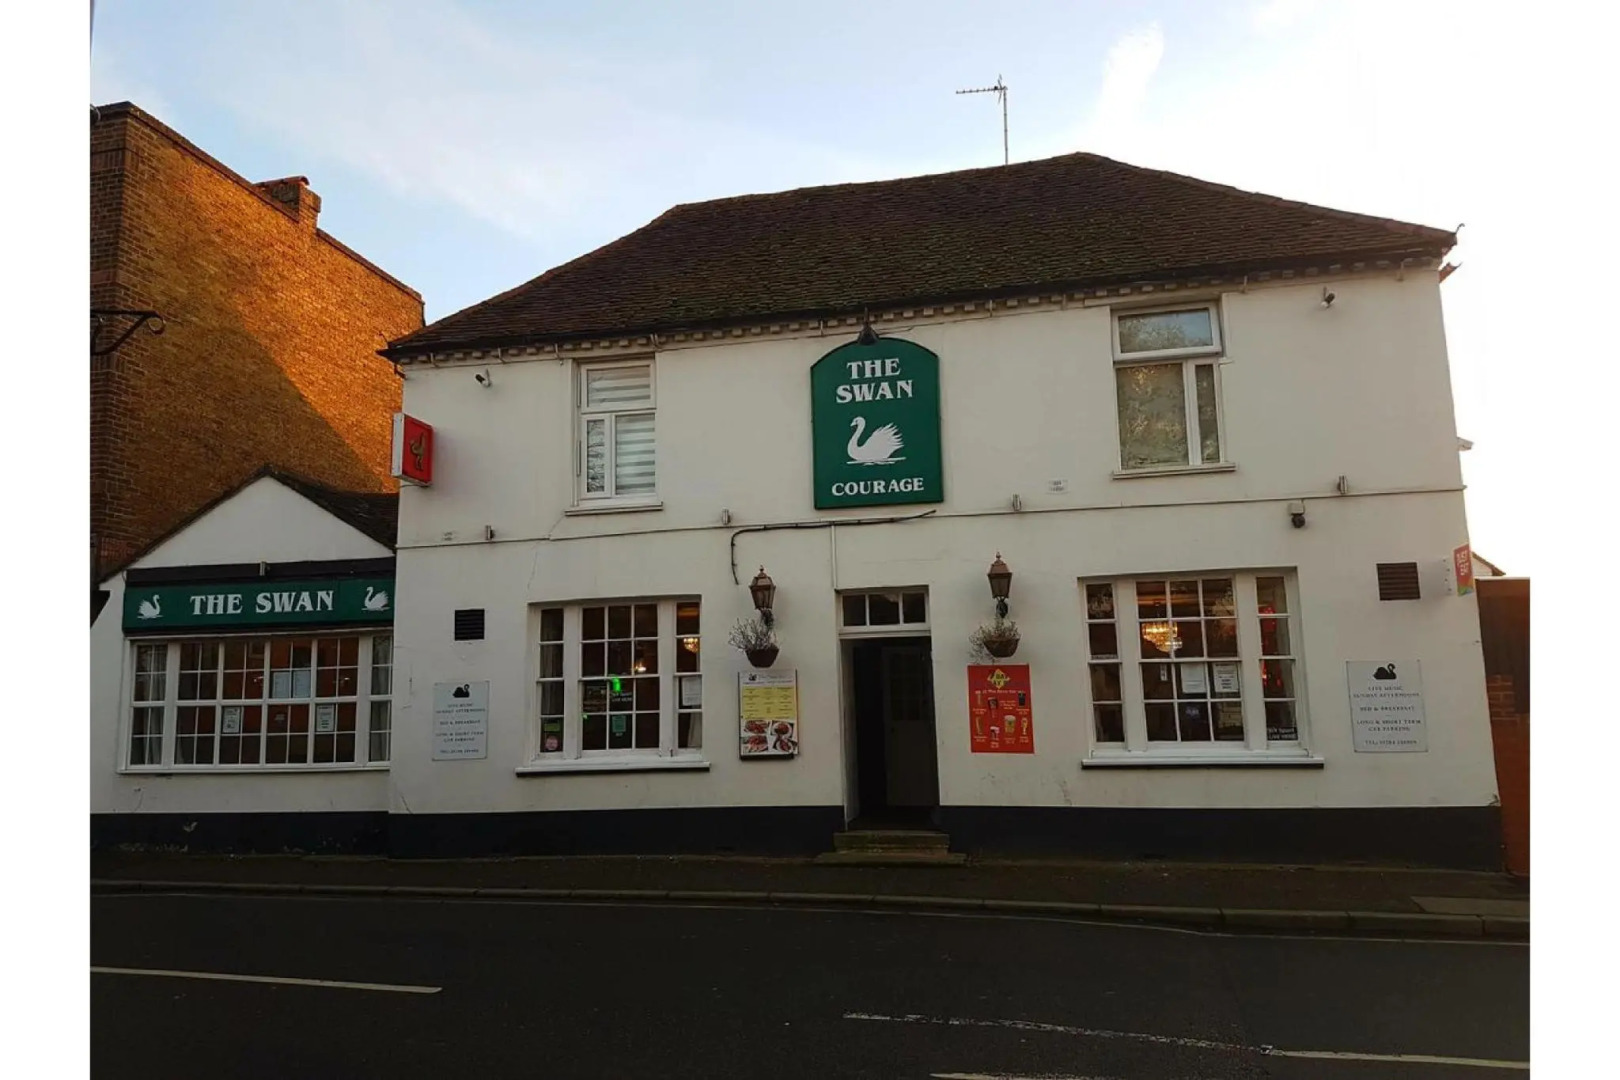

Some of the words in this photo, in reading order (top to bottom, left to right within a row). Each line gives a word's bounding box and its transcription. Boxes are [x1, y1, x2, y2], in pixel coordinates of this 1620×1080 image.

[846, 358, 901, 379] THE
[836, 380, 913, 404] SWAN
[831, 477, 925, 496] COURAGE
[190, 594, 243, 615] THE
[255, 590, 334, 614] SWAN
